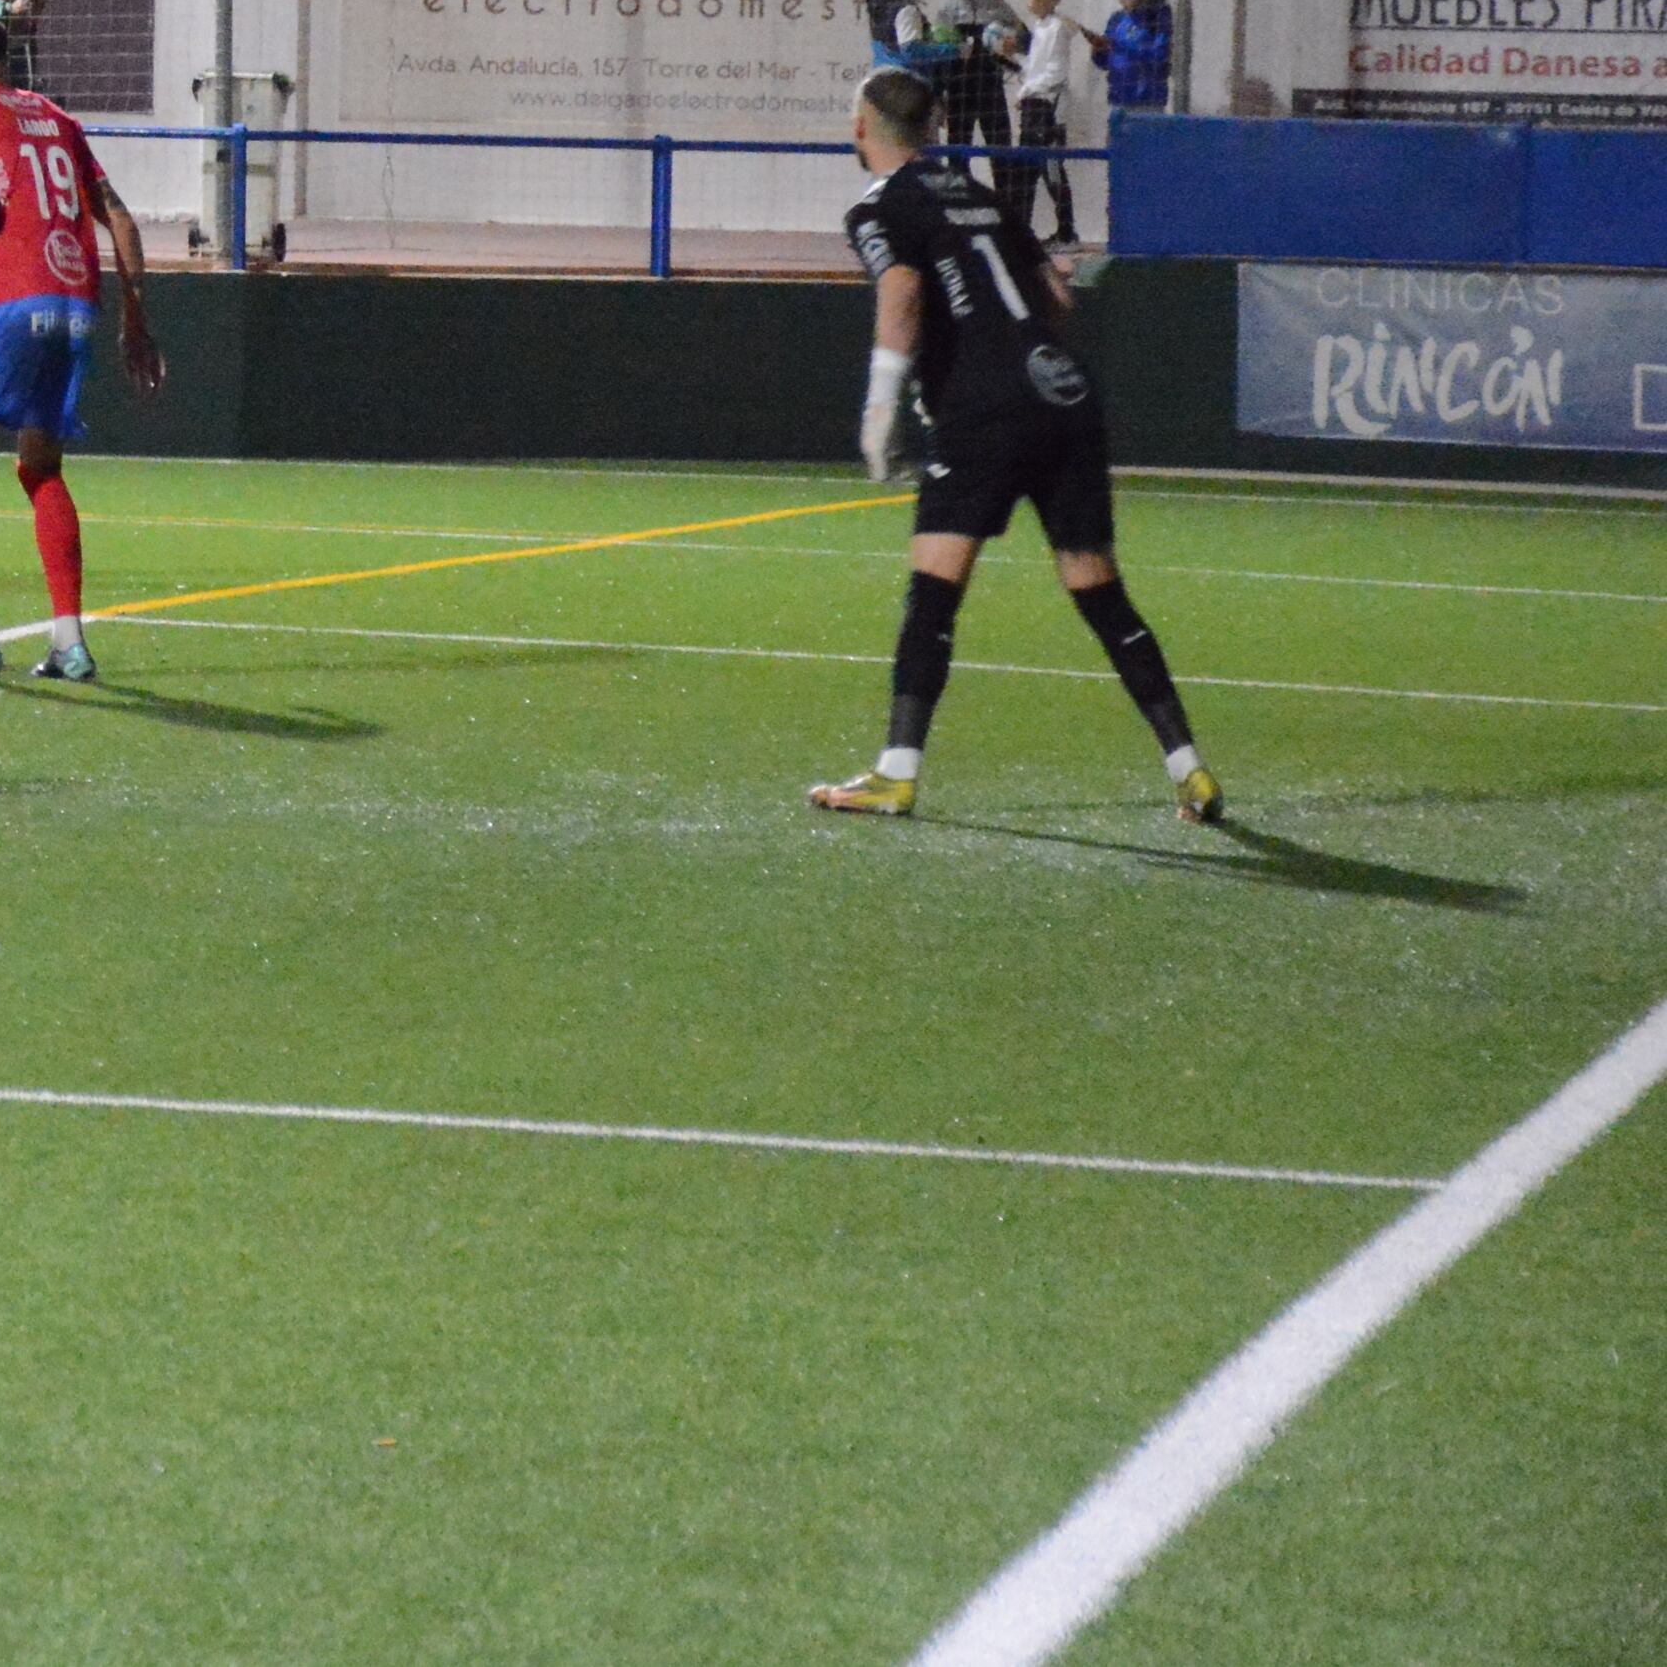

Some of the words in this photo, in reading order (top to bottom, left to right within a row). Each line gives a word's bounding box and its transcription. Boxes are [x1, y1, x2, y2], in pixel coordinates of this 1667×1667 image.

[644, 58, 709, 79] Torre
[715, 58, 751, 80] del
[757, 59, 802, 80] Mar
[1348, 43, 1491, 75] Calidad
[1502, 46, 1641, 78] Danesa
[19, 143, 81, 223] 19
